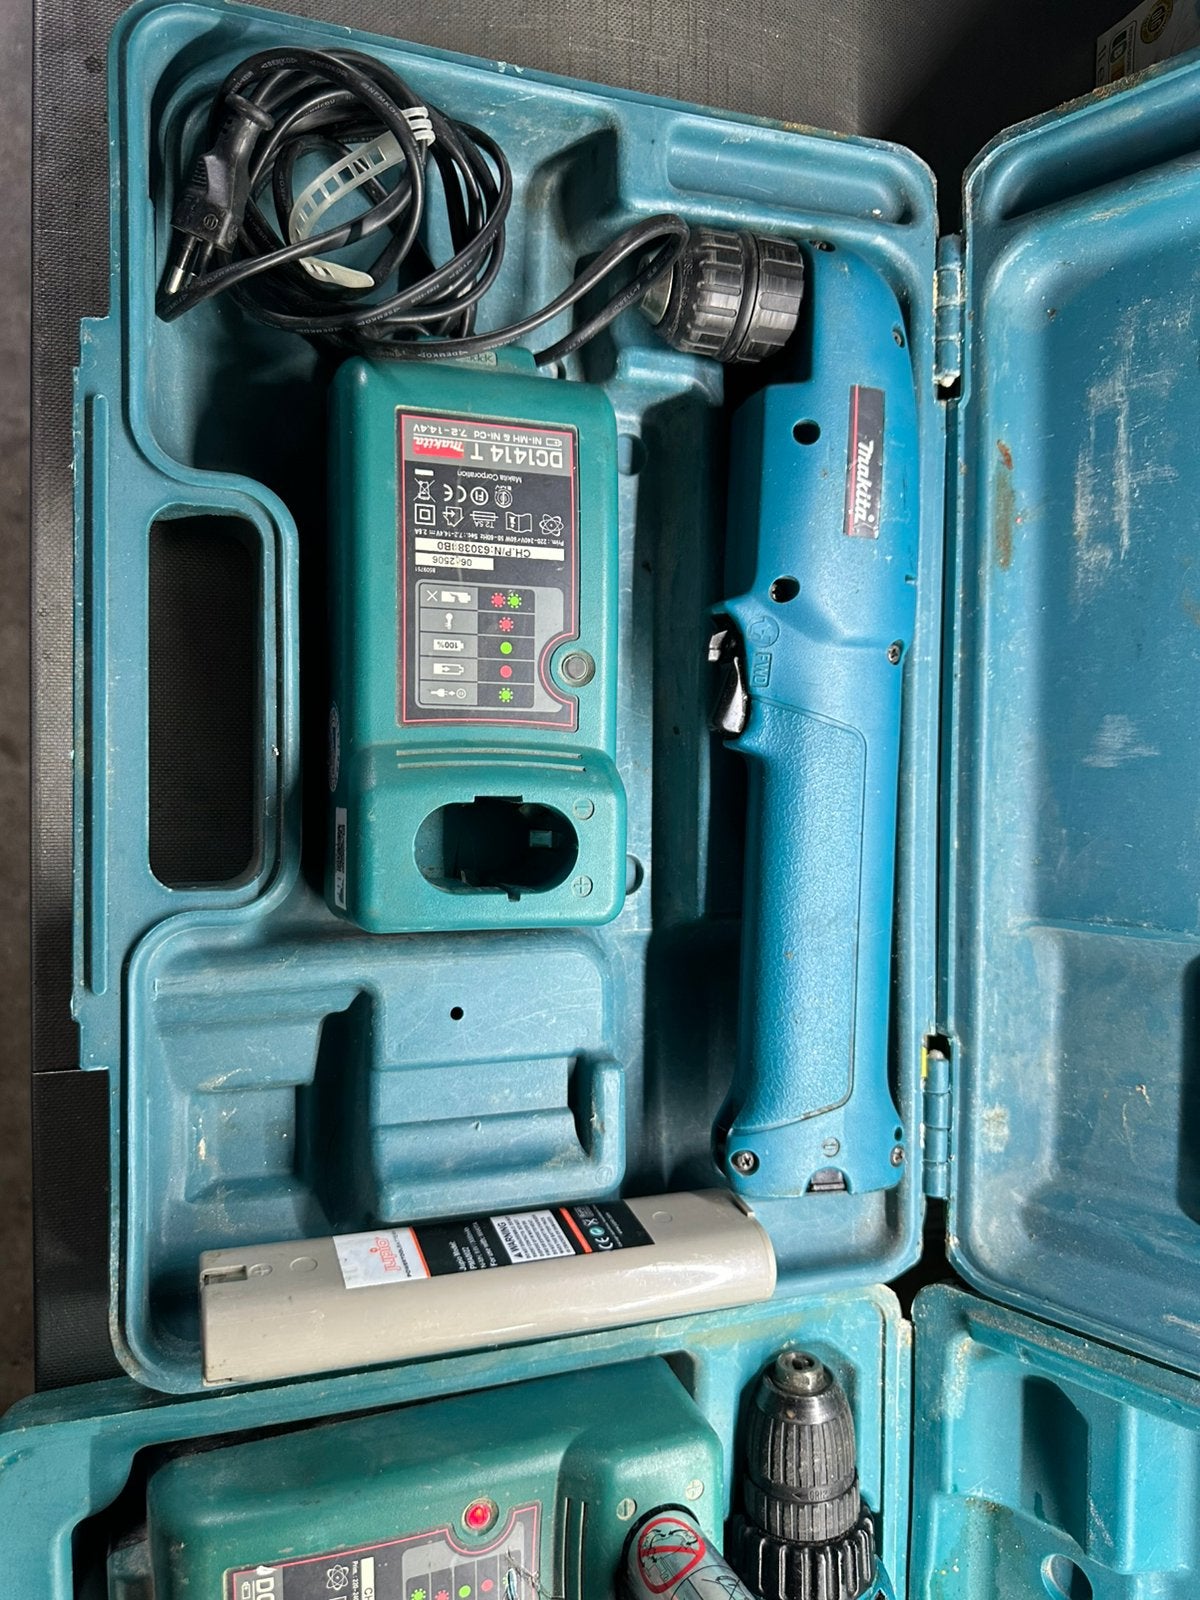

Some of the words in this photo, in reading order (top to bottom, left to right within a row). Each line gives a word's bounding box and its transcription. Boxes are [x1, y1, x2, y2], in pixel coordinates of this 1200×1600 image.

[470, 443, 483, 461] T
[490, 444, 563, 469] DC1414
[457, 470, 498, 482] Corporation
[499, 474, 522, 484] Makita
[854, 440, 875, 524] makita
[437, 641, 458, 649] 100%
[752, 653, 771, 684] FWD
[497, 1221, 518, 1253] WARNING
